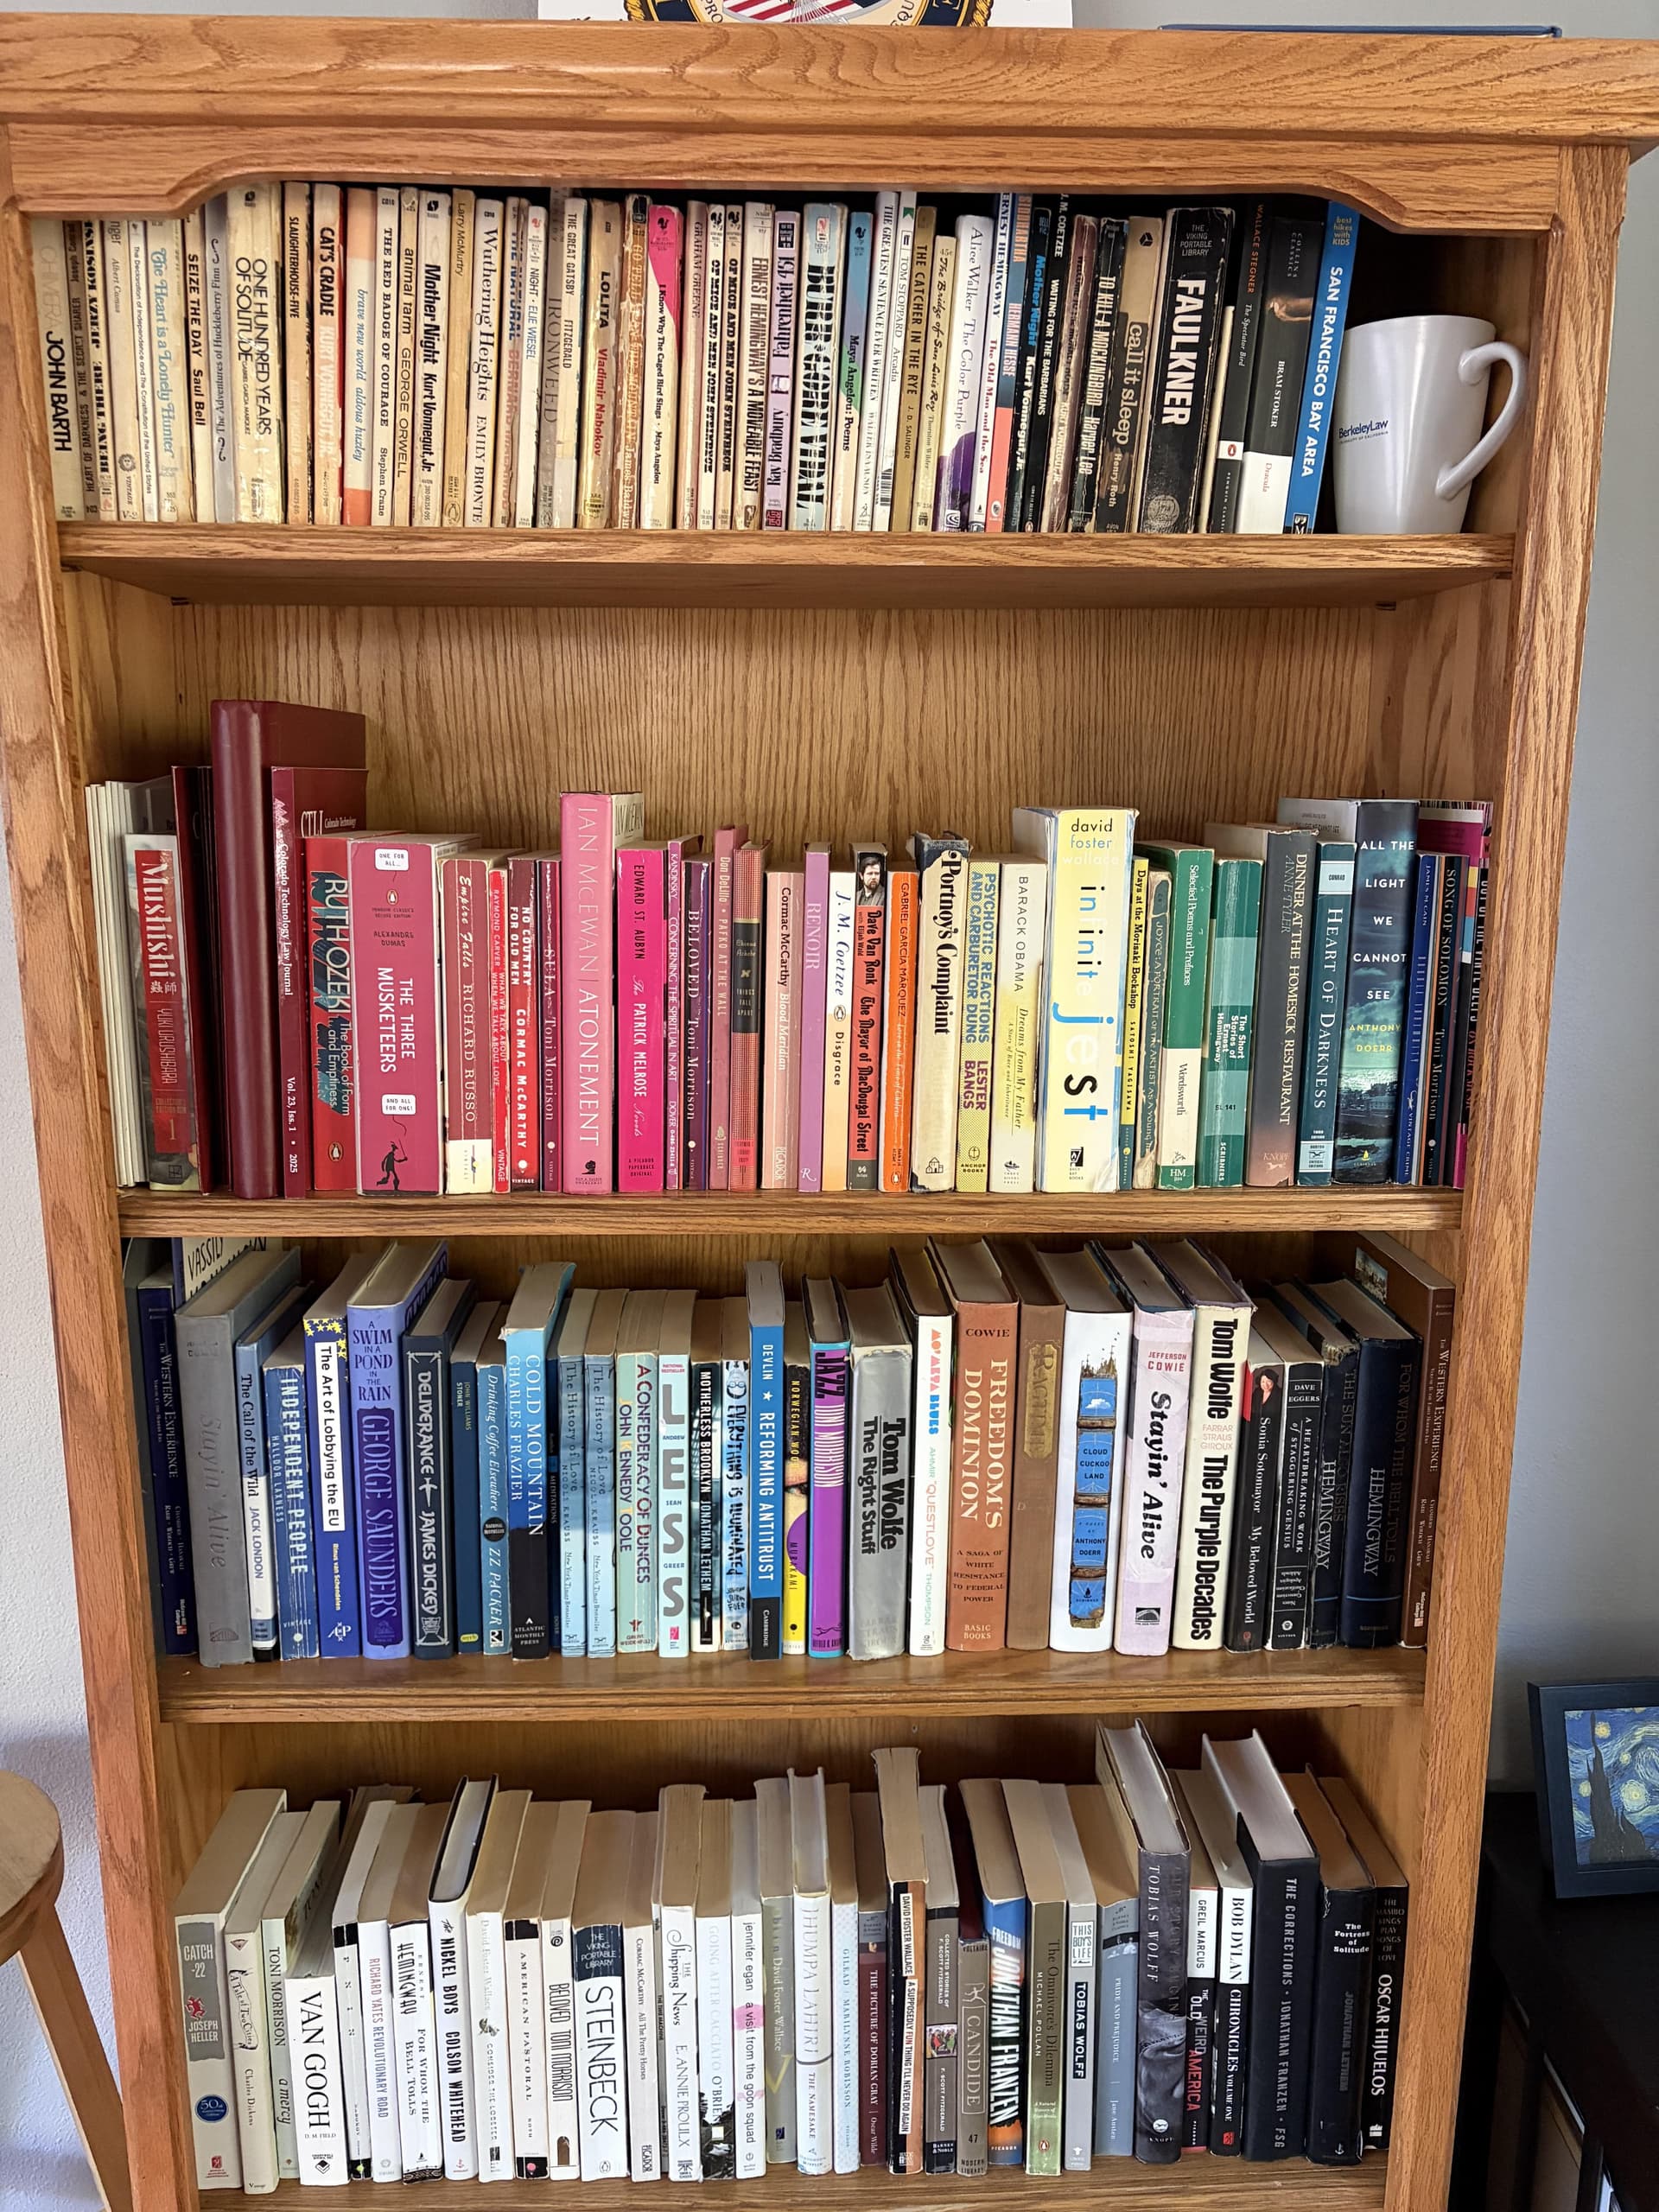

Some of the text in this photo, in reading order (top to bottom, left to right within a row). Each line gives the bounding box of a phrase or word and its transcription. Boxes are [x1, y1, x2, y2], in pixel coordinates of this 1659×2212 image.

[188, 253, 200, 294] SEIZE
[188, 297, 201, 323] THE
[235, 257, 252, 361] OF SOLITUDE
[319, 226, 334, 316] CAT'S CRADLE
[475, 228, 499, 327] Wuthering
[190, 326, 202, 357] DAY
[193, 369, 204, 397] Saul
[252, 259, 270, 435] ONE HUNDRED YEARS
[353, 289, 367, 461] brave new world aldous huxley
[473, 331, 496, 402] Heights
[594, 271, 611, 457] LOLITA Vladimir Nabokov
[1161, 279, 1206, 425] FAULKNER
[1300, 267, 1344, 477] SAN FRANCISCO BAY AREA
[46, 331, 72, 452] JOHN BARTH
[1108, 324, 1144, 507] call it sleep Henry Roth
[1270, 360, 1285, 428] BRAM STOKER
[475, 415, 486, 461] EMILY
[280, 843, 291, 887] Colorado
[1361, 842, 1415, 850] ALL THE
[1365, 879, 1406, 888] LIGHT
[142, 863, 175, 978] Mushishi
[279, 888, 292, 939] Technology
[283, 942, 292, 961] Law
[322, 880, 350, 1014] RUTH OZEKI
[805, 903, 822, 970] RENOIR
[931, 859, 962, 1034] Portnoy's Complaint
[1353, 953, 1407, 963] CANNOT
[1373, 917, 1393, 926] WE
[283, 963, 294, 995] Journal
[378, 967, 396, 1072] MUSKETEERS
[399, 978, 415, 1059] THE THREE
[459, 875, 475, 1122] Empire Falls RICHARD RUSSO
[578, 807, 598, 1147] IAN McEWAN ATONEMENT
[632, 865, 648, 1137] EDWARD ST. AUBYN The PATRICK MELROSE Novels
[1313, 908, 1343, 1109] HEART OF DARKNESS
[1367, 991, 1389, 1000] SEE
[1350, 1024, 1401, 1033] ANTHONY
[286, 1096, 296, 1108] 23,
[287, 1077, 296, 1094] Vol.
[288, 1109, 296, 1124] Iss.
[289, 1154, 298, 1173] 2025
[321, 1346, 339, 1527] The Art of Lobbying the EU
[509, 1355, 523, 1500] CHARLES FRAZIER
[526, 1355, 543, 1535] COLD MOUNTAIN
[758, 1344, 775, 1580] DEVLIN REFORMING ANTITRUST
[960, 1369, 983, 1521] DOMINION
[985, 1359, 1007, 1529] FREEDOM'S
[281, 1378, 308, 1574] INDEPENDENT PEOPLE
[363, 1414, 396, 1618] GEORGE SAUNDERS
[417, 1371, 437, 1615] DELIVERANCE JAMES DICKEY
[857, 1416, 877, 1554] The Right Stuff
[881, 1418, 906, 1549] Tom Wolfe
[1141, 1391, 1171, 1559] Stayin' Alive
[1191, 1319, 1238, 1640] Tom Wolfe The Purple Decades
[742, 1922, 756, 1961] jennifer
[1196, 1899, 1206, 1969] GREIL MARCUS
[1229, 1931, 1244, 1980] DYLAN
[1230, 1897, 1245, 1927] BOB
[269, 1947, 281, 1977] TONI
[742, 1964, 753, 1991] egan
[271, 1981, 285, 2046] MORRISON
[440, 1919, 466, 2143] The NICKEL BOYS COLSON WHITEHEAD
[746, 2012, 757, 2033] visit
[746, 2037, 757, 2060] from
[989, 1947, 1021, 2126] JONATHAN FRANZEN
[1074, 1983, 1087, 2078] TOBIAS WOLFF
[1226, 1989, 1241, 2072] CHRONICLES
[1371, 1974, 1392, 2095] OSCAR HIJUELOS
[299, 1991, 330, 2128] VAN GOGH
[585, 1986, 619, 2135] STEINBECK
[743, 2083, 754, 2109] goon
[746, 2064, 757, 2079] the
[967, 2015, 981, 2107] CANDIDE
[276, 2088, 292, 2124] mercy
[742, 2113, 756, 2144] squad
